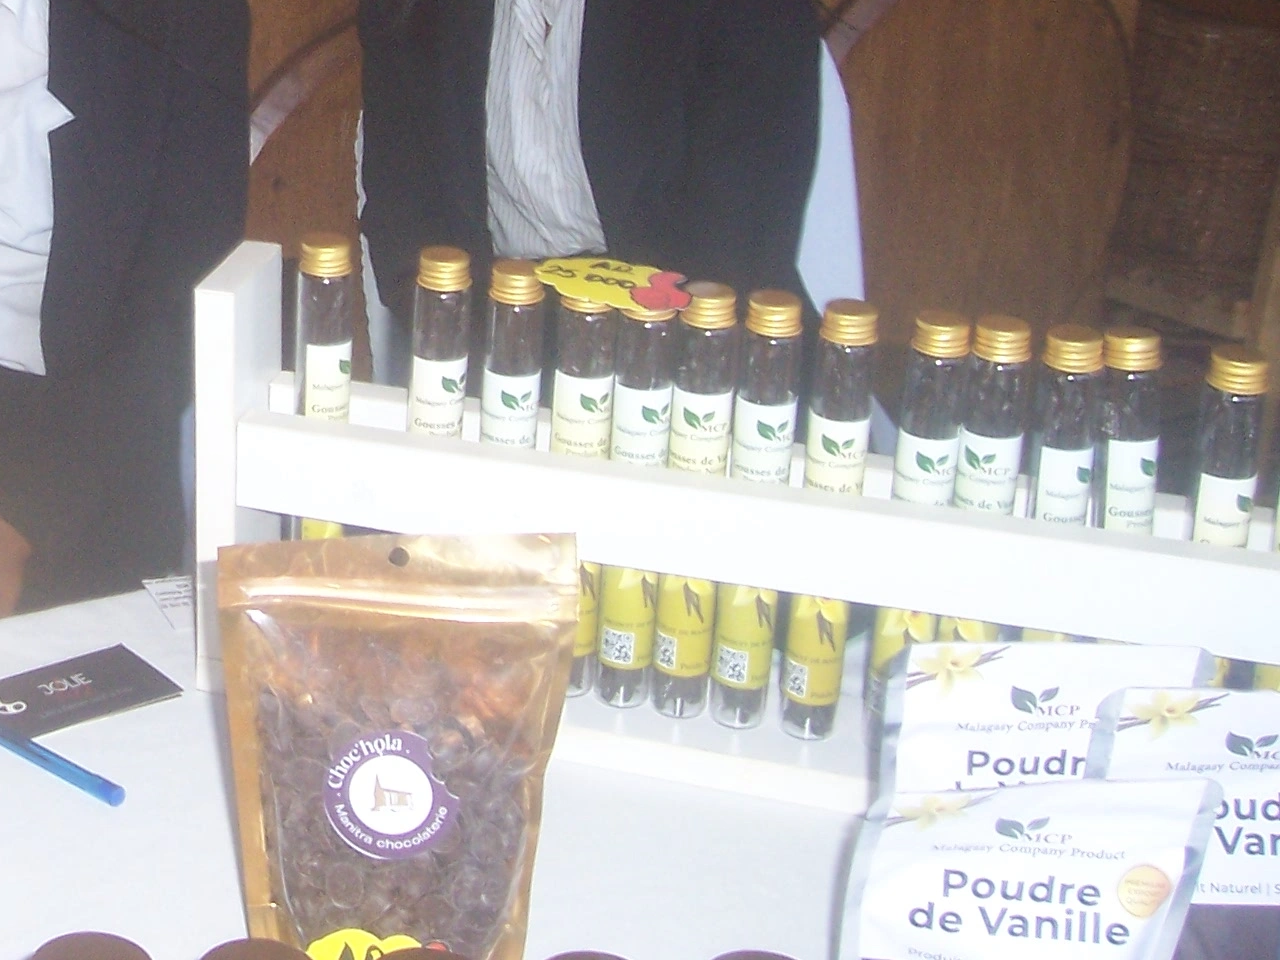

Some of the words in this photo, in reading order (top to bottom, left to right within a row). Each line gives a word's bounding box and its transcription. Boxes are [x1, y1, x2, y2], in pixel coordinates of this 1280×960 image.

[966, 749, 1086, 776] Poudr
[334, 803, 374, 845] Manitra
[942, 868, 1102, 907] Poudre
[908, 901, 963, 934] de
[977, 905, 1131, 947] Vanille
